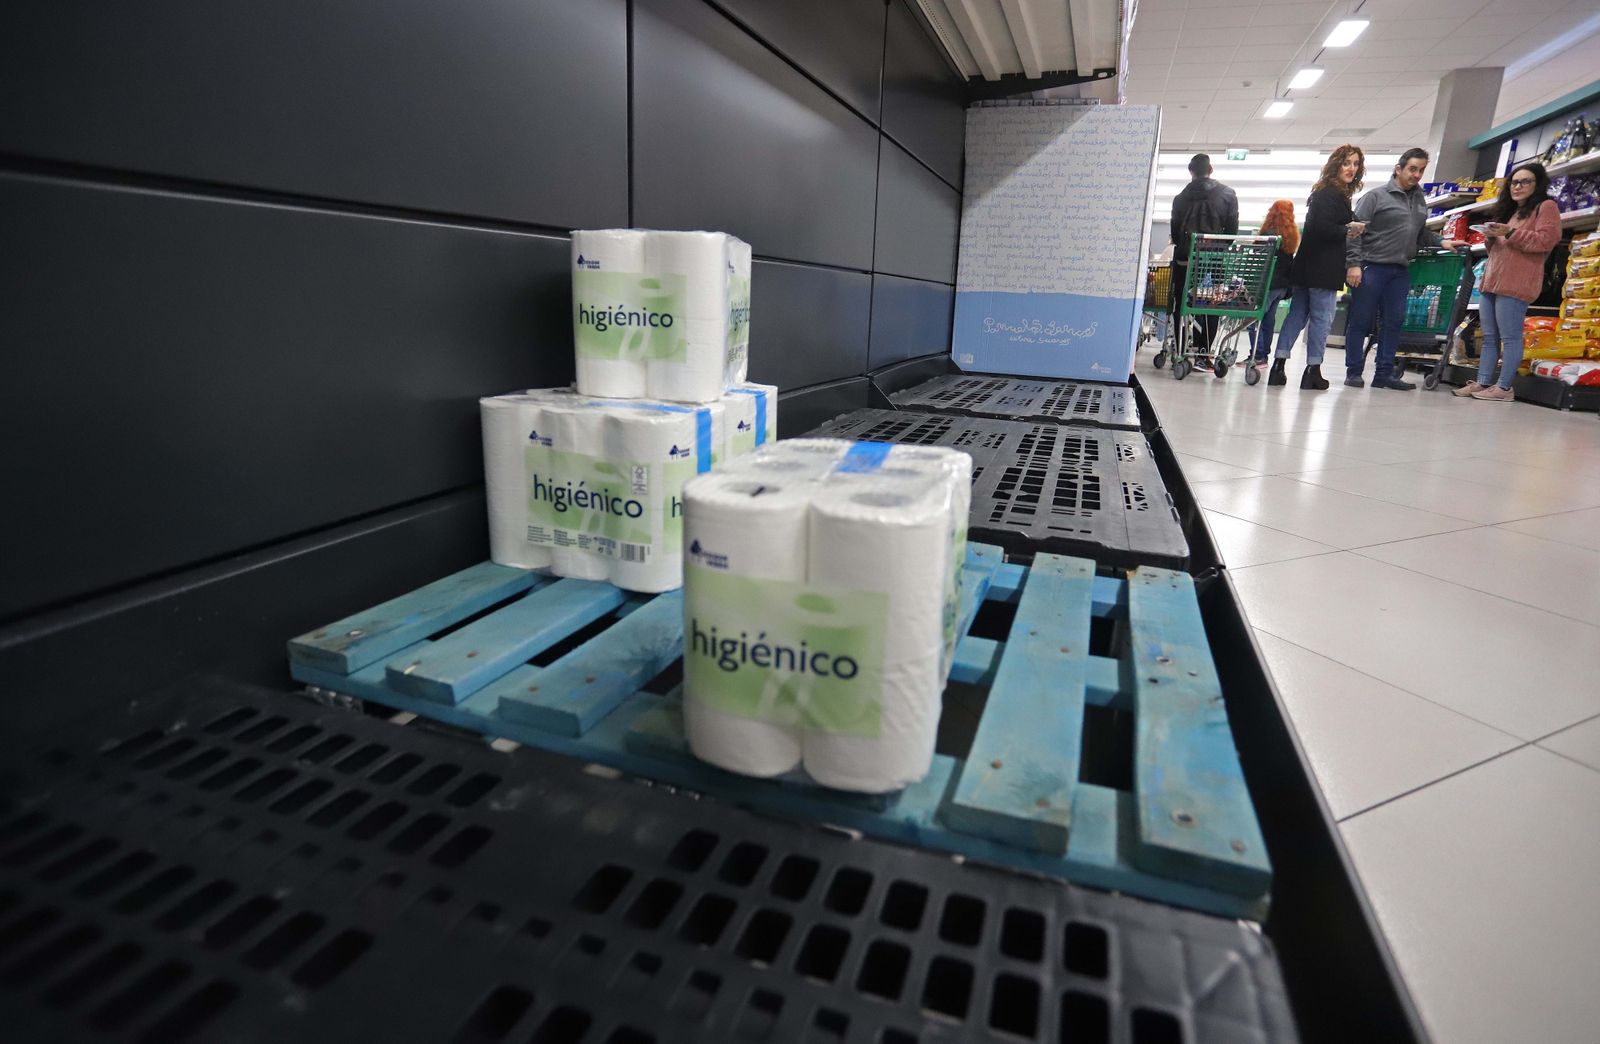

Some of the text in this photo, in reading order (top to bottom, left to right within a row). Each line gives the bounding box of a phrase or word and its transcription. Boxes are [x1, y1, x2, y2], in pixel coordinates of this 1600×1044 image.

[579, 304, 674, 332] higiénico
[532, 474, 643, 519] higiénico
[691, 618, 859, 680] higiénico
